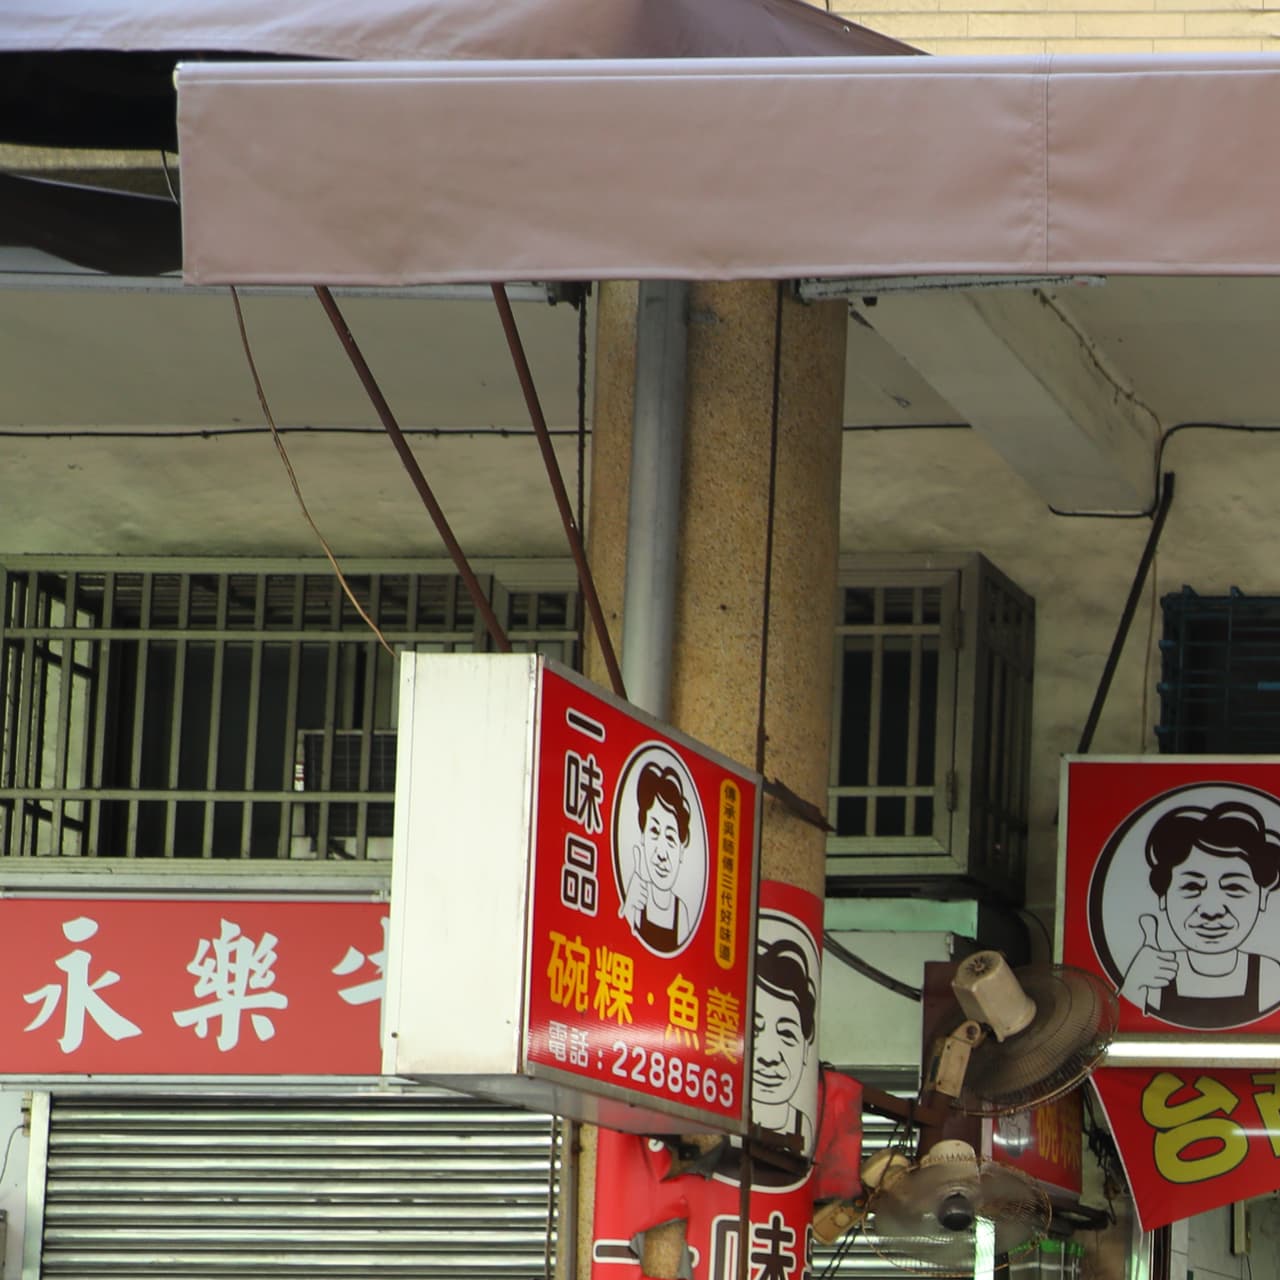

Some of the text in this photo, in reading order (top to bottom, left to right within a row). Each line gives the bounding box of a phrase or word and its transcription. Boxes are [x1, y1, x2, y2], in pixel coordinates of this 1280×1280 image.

[561, 706, 607, 918] 一味品
[718, 781, 737, 967] 傳承吳師傅三代好味道
